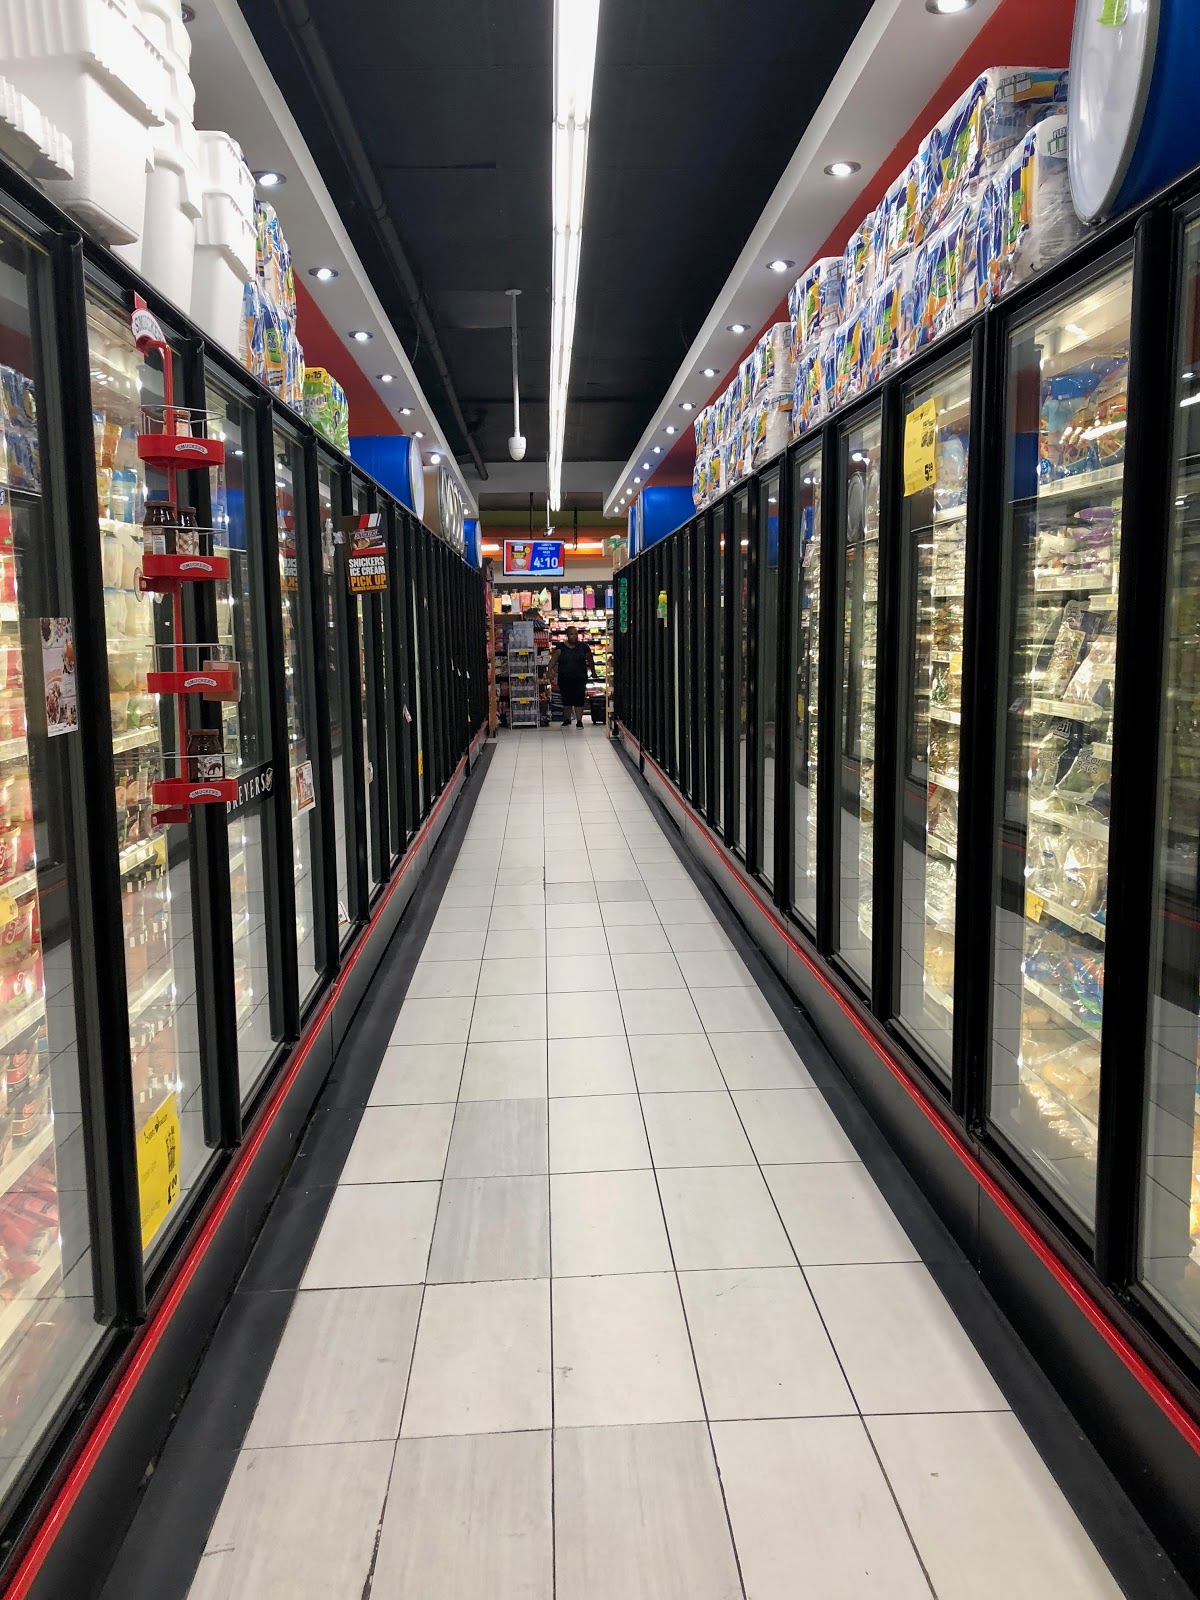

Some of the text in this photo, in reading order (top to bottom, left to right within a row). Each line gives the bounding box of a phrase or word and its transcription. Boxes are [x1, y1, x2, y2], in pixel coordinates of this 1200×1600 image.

[348, 556, 385, 568] SNICKERS
[349, 565, 386, 577] ICE CREAM
[350, 574, 387, 588] PICK UP
